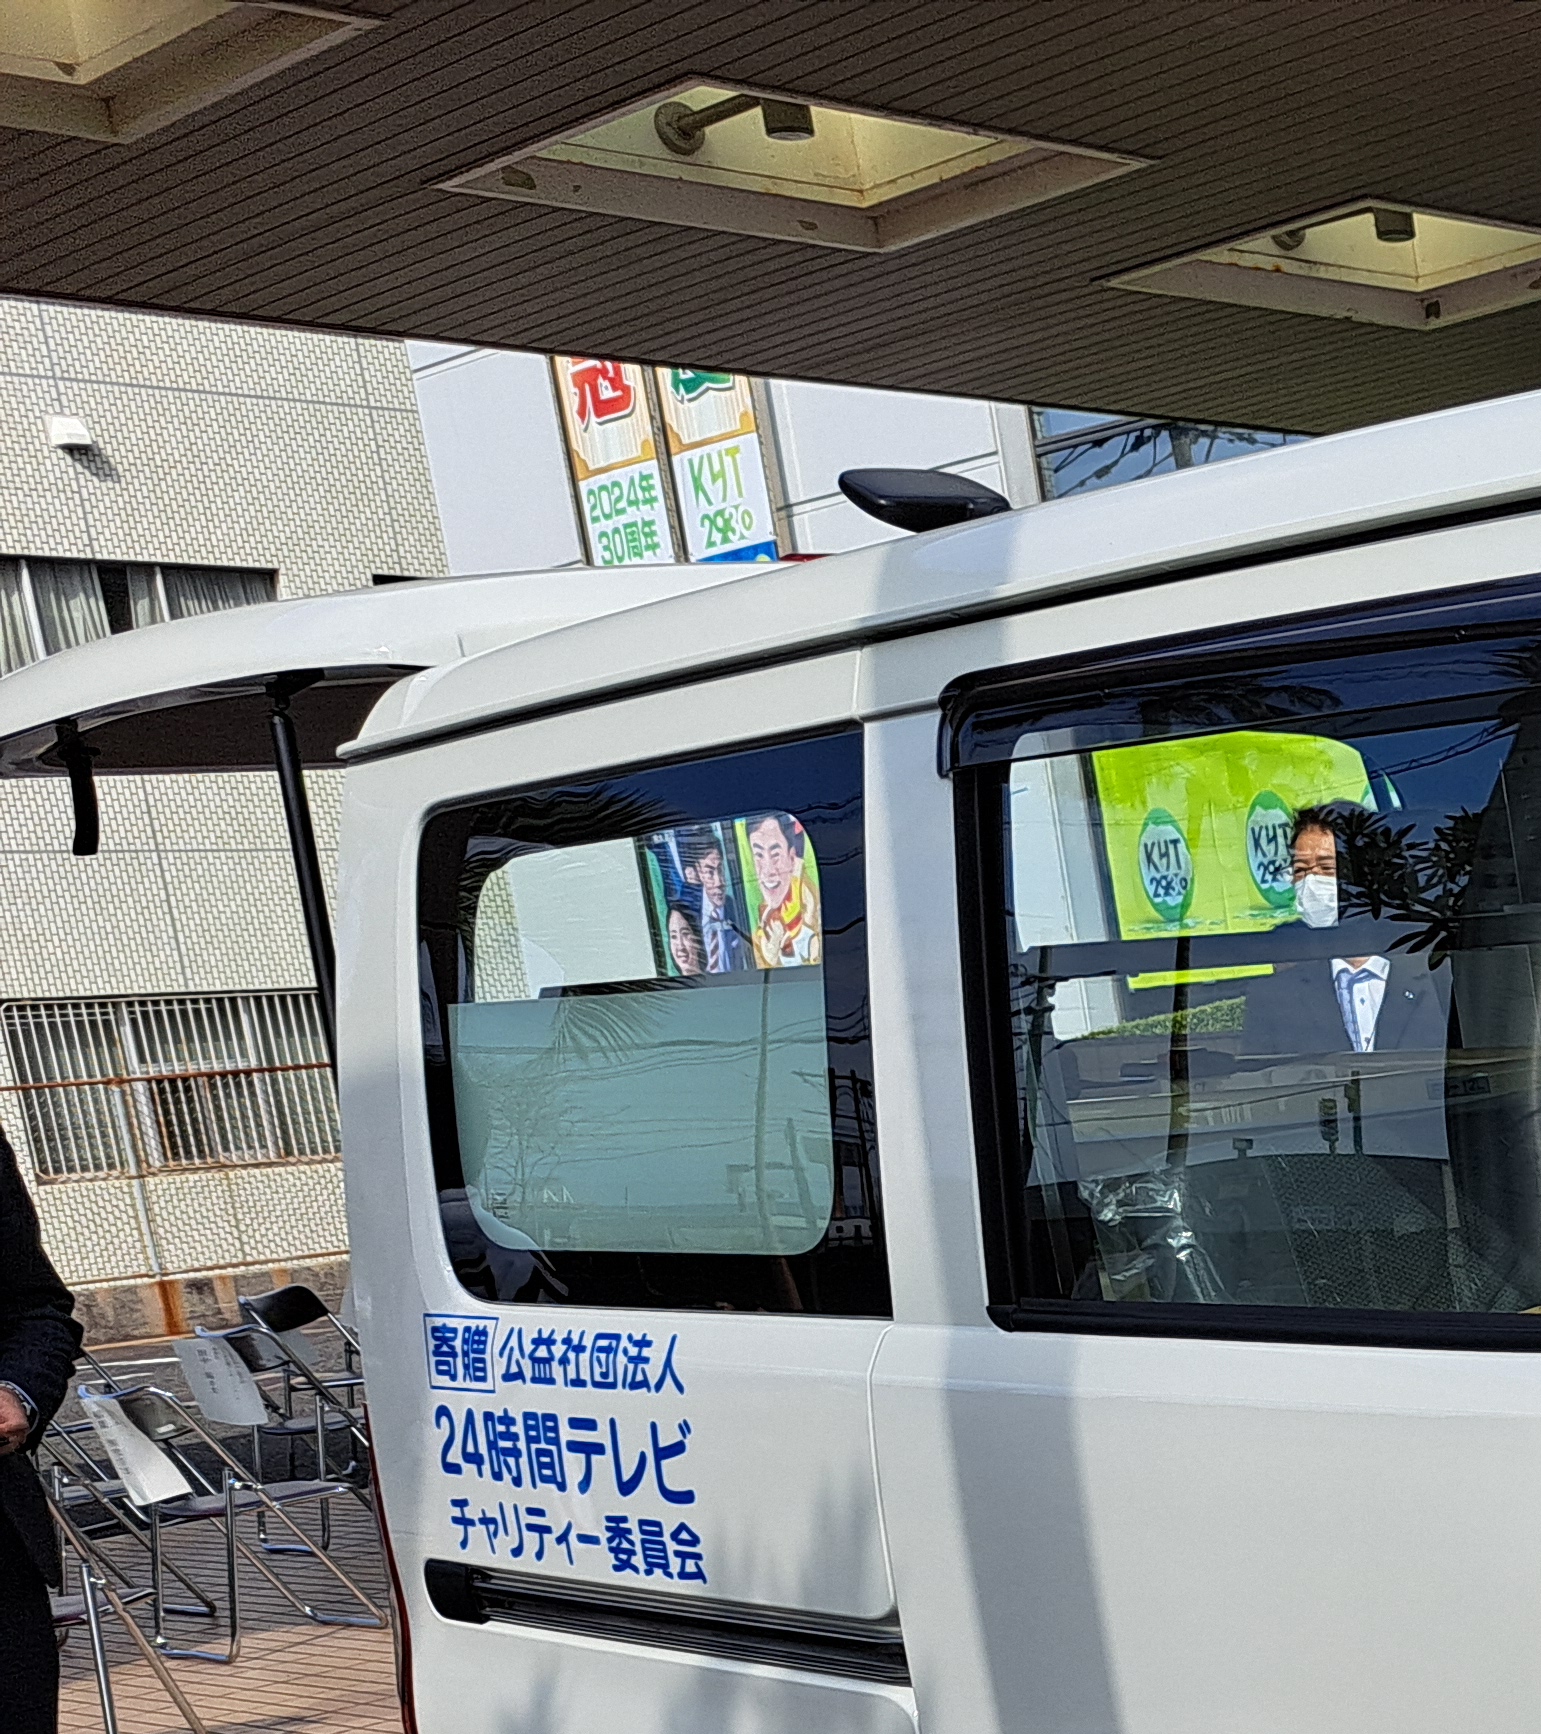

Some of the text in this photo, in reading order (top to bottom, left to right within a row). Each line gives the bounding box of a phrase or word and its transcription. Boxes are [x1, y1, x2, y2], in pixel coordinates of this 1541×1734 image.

[586, 471, 659, 525] 2024年
[687, 445, 745, 509] KYT
[597, 517, 661, 566] 30周年
[431, 1323, 686, 1395] 寄贈 公益社団法人
[434, 1403, 697, 1505] 24時間テレビ
[449, 1497, 708, 1584] チャリティー委員会
